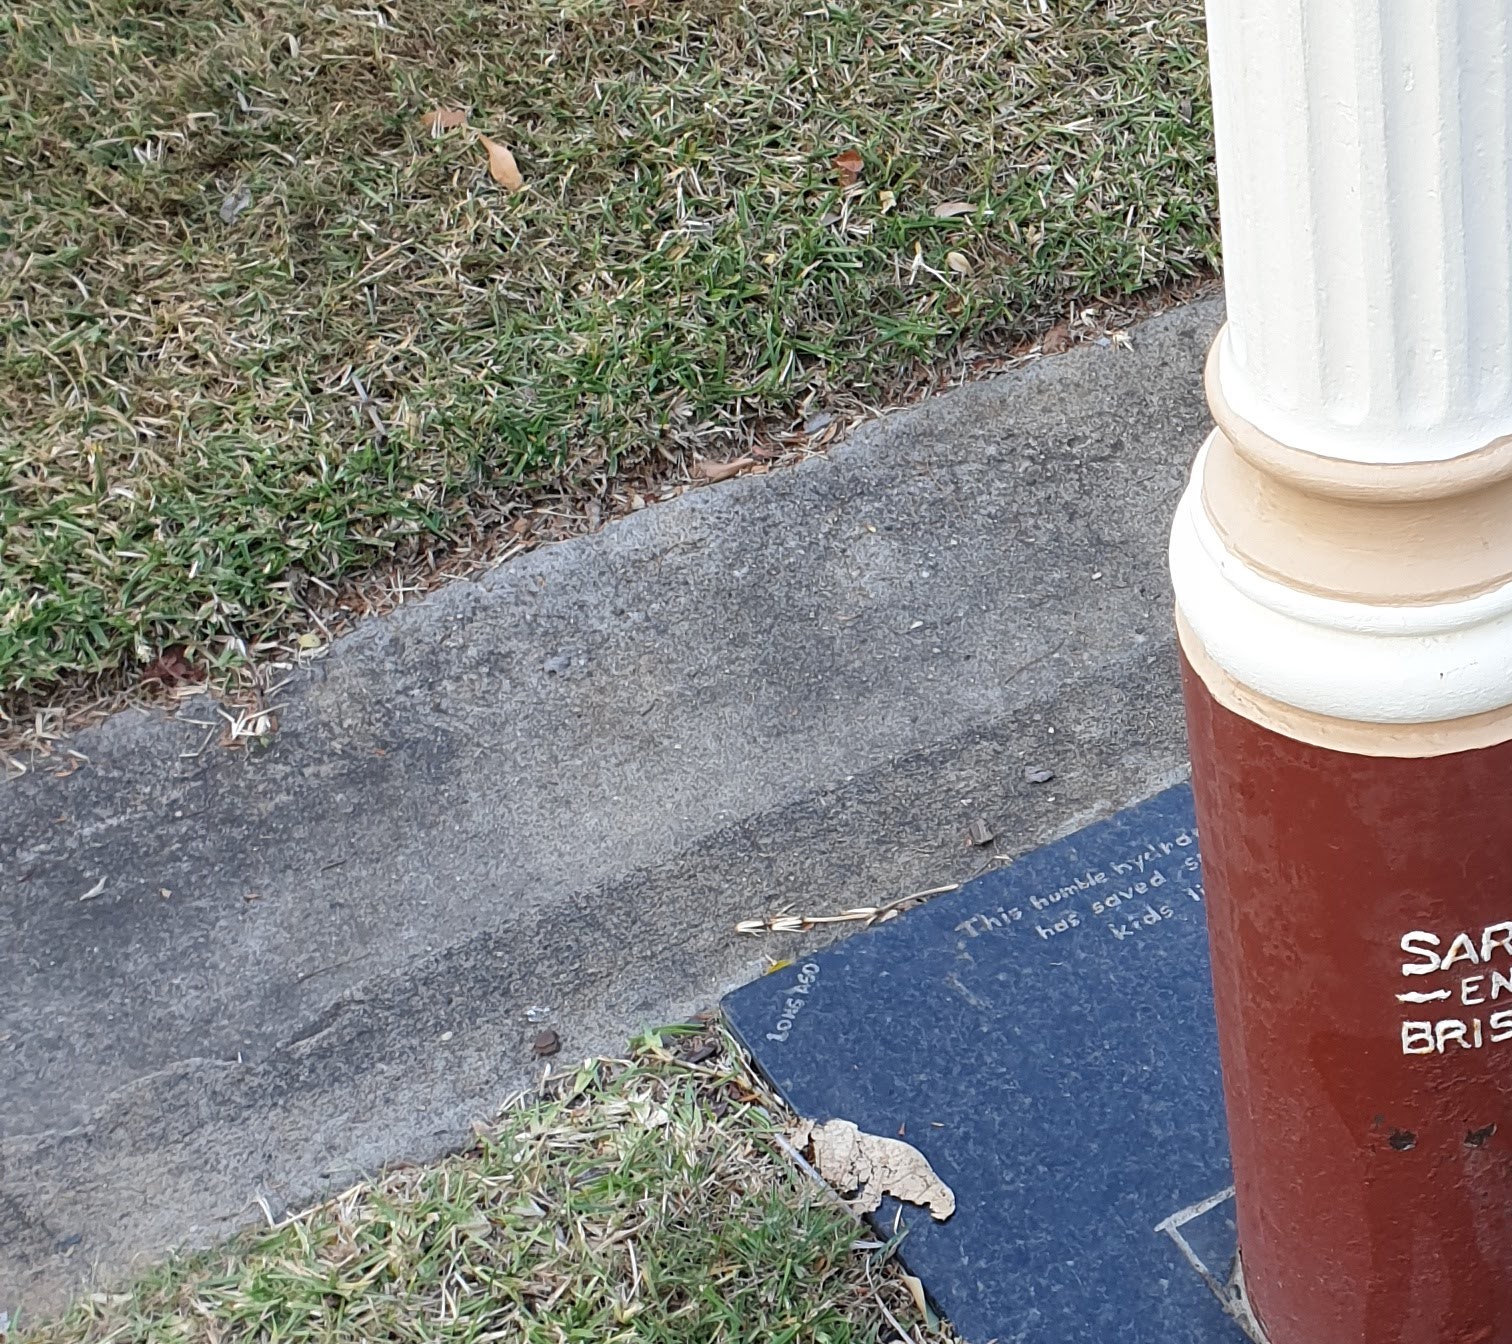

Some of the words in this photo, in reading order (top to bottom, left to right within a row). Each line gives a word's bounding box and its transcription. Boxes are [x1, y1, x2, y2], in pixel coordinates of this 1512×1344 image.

[953, 905, 1023, 938] This
[1029, 870, 1109, 911] humble
[1034, 912, 1081, 940] has
[1091, 869, 1167, 915] saved
[1110, 903, 1175, 942] kids
